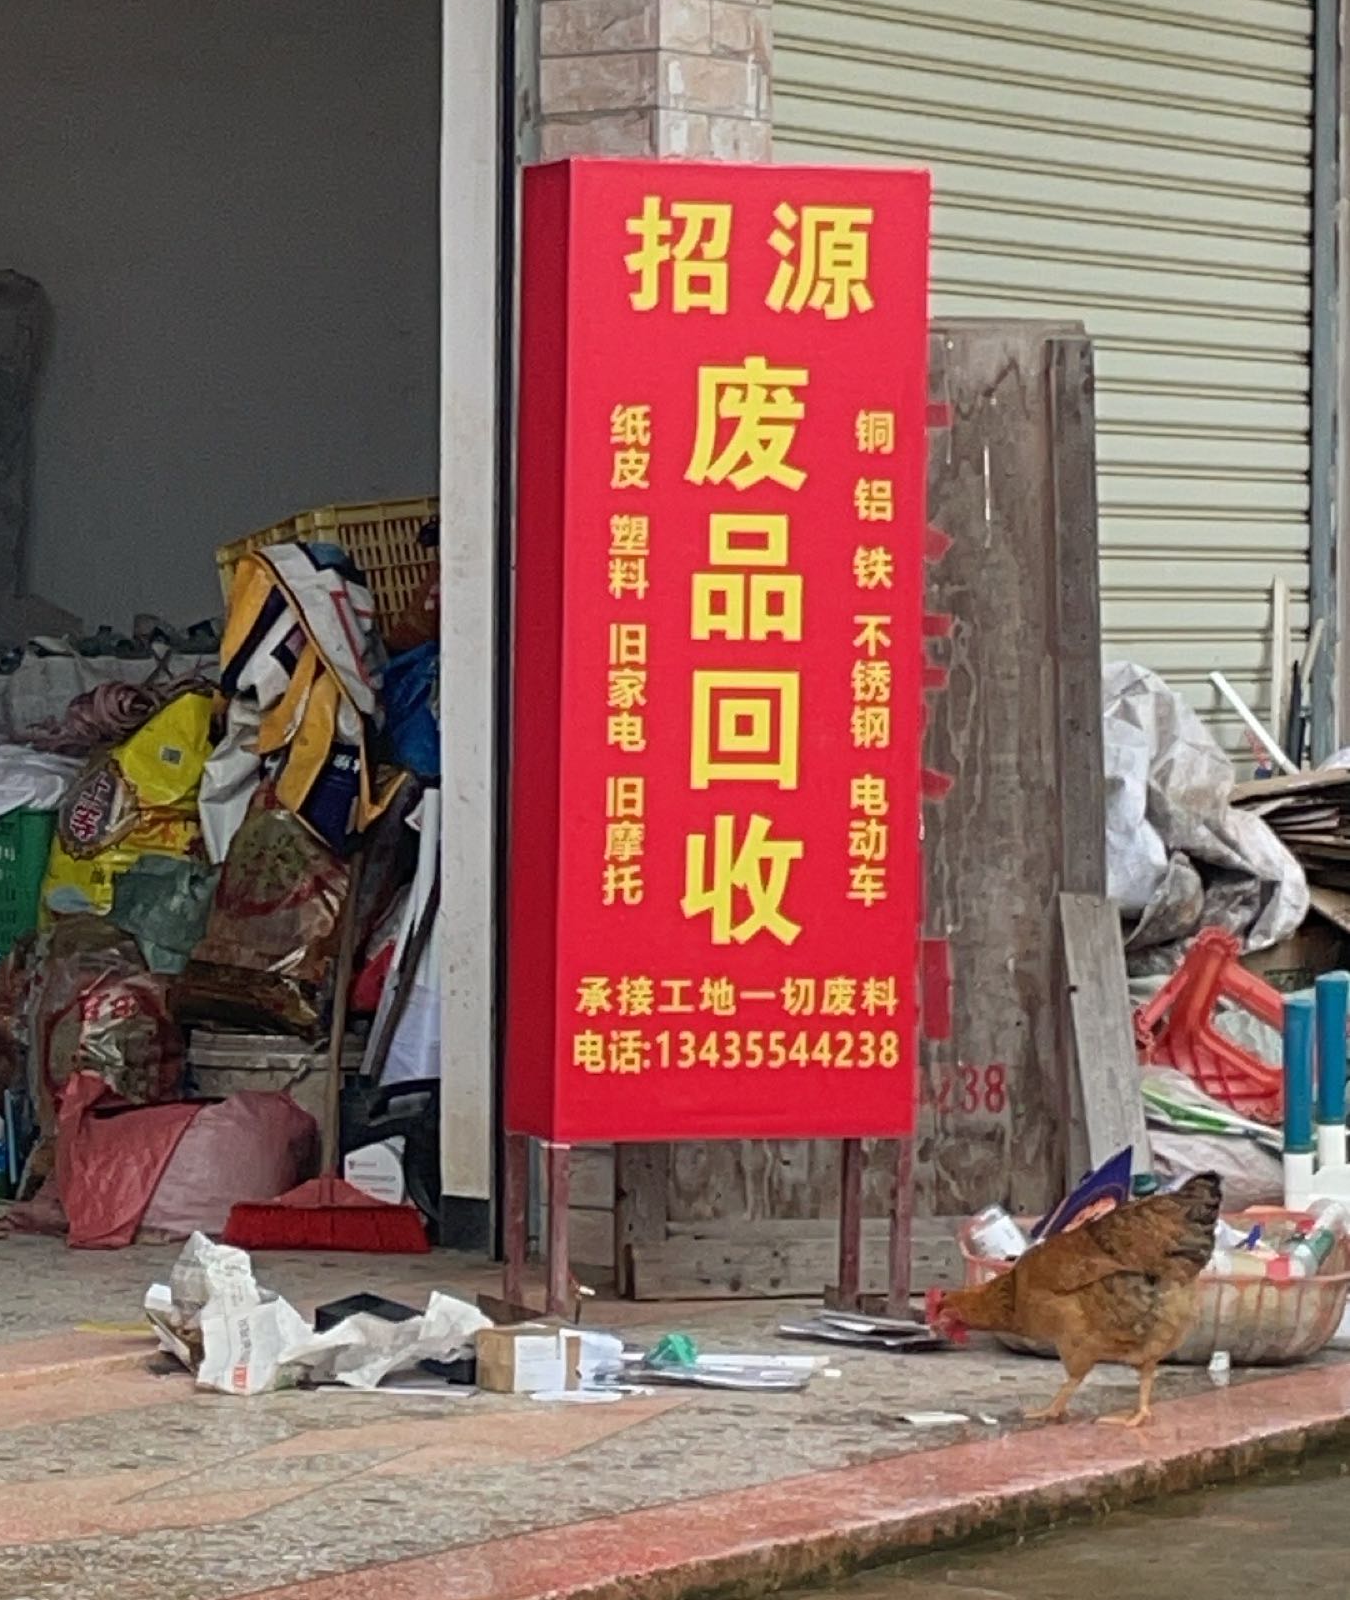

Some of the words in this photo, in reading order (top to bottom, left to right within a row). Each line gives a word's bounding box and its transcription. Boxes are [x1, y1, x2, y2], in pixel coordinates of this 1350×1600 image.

[623, 196, 876, 321] 招源
[610, 404, 652, 490] 纸皮
[854, 409, 896, 456] 铜
[853, 478, 894, 523] 铝
[608, 514, 651, 600] 塑料
[852, 546, 894, 590] 铁
[607, 623, 648, 753] 旧家电
[681, 356, 810, 946] 废品回收
[851, 615, 892, 749] 不锈钢
[602, 777, 646, 906] 旧摩托
[846, 774, 890, 908] 电动车
[575, 976, 900, 1017] 承接工地一切废料
[572, 1030, 901, 1074] 电话:13435544238
